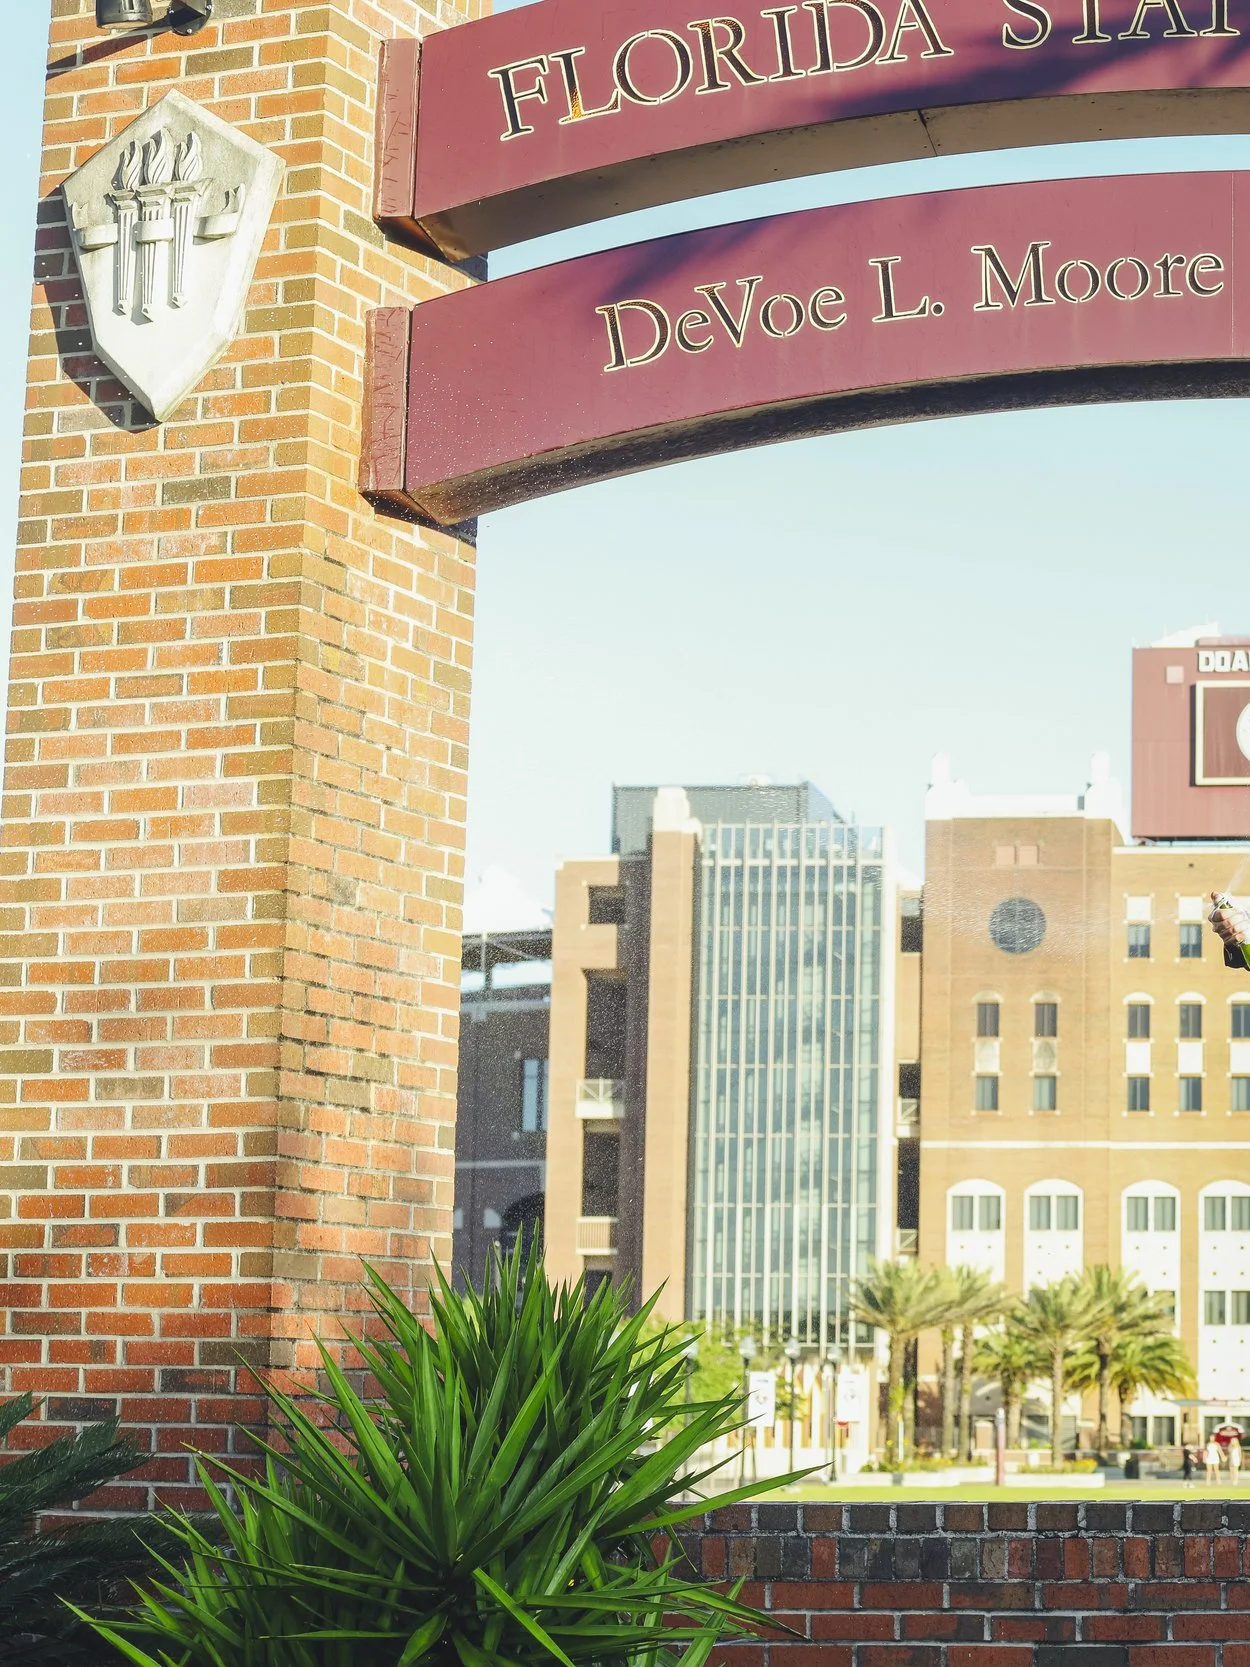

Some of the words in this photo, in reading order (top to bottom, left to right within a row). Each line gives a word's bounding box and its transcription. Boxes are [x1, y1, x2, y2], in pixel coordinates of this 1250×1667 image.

[488, 0, 954, 141] FLORIDA
[596, 275, 847, 373] DeVoe
[870, 256, 945, 322] L.
[972, 241, 1225, 311] Moore
